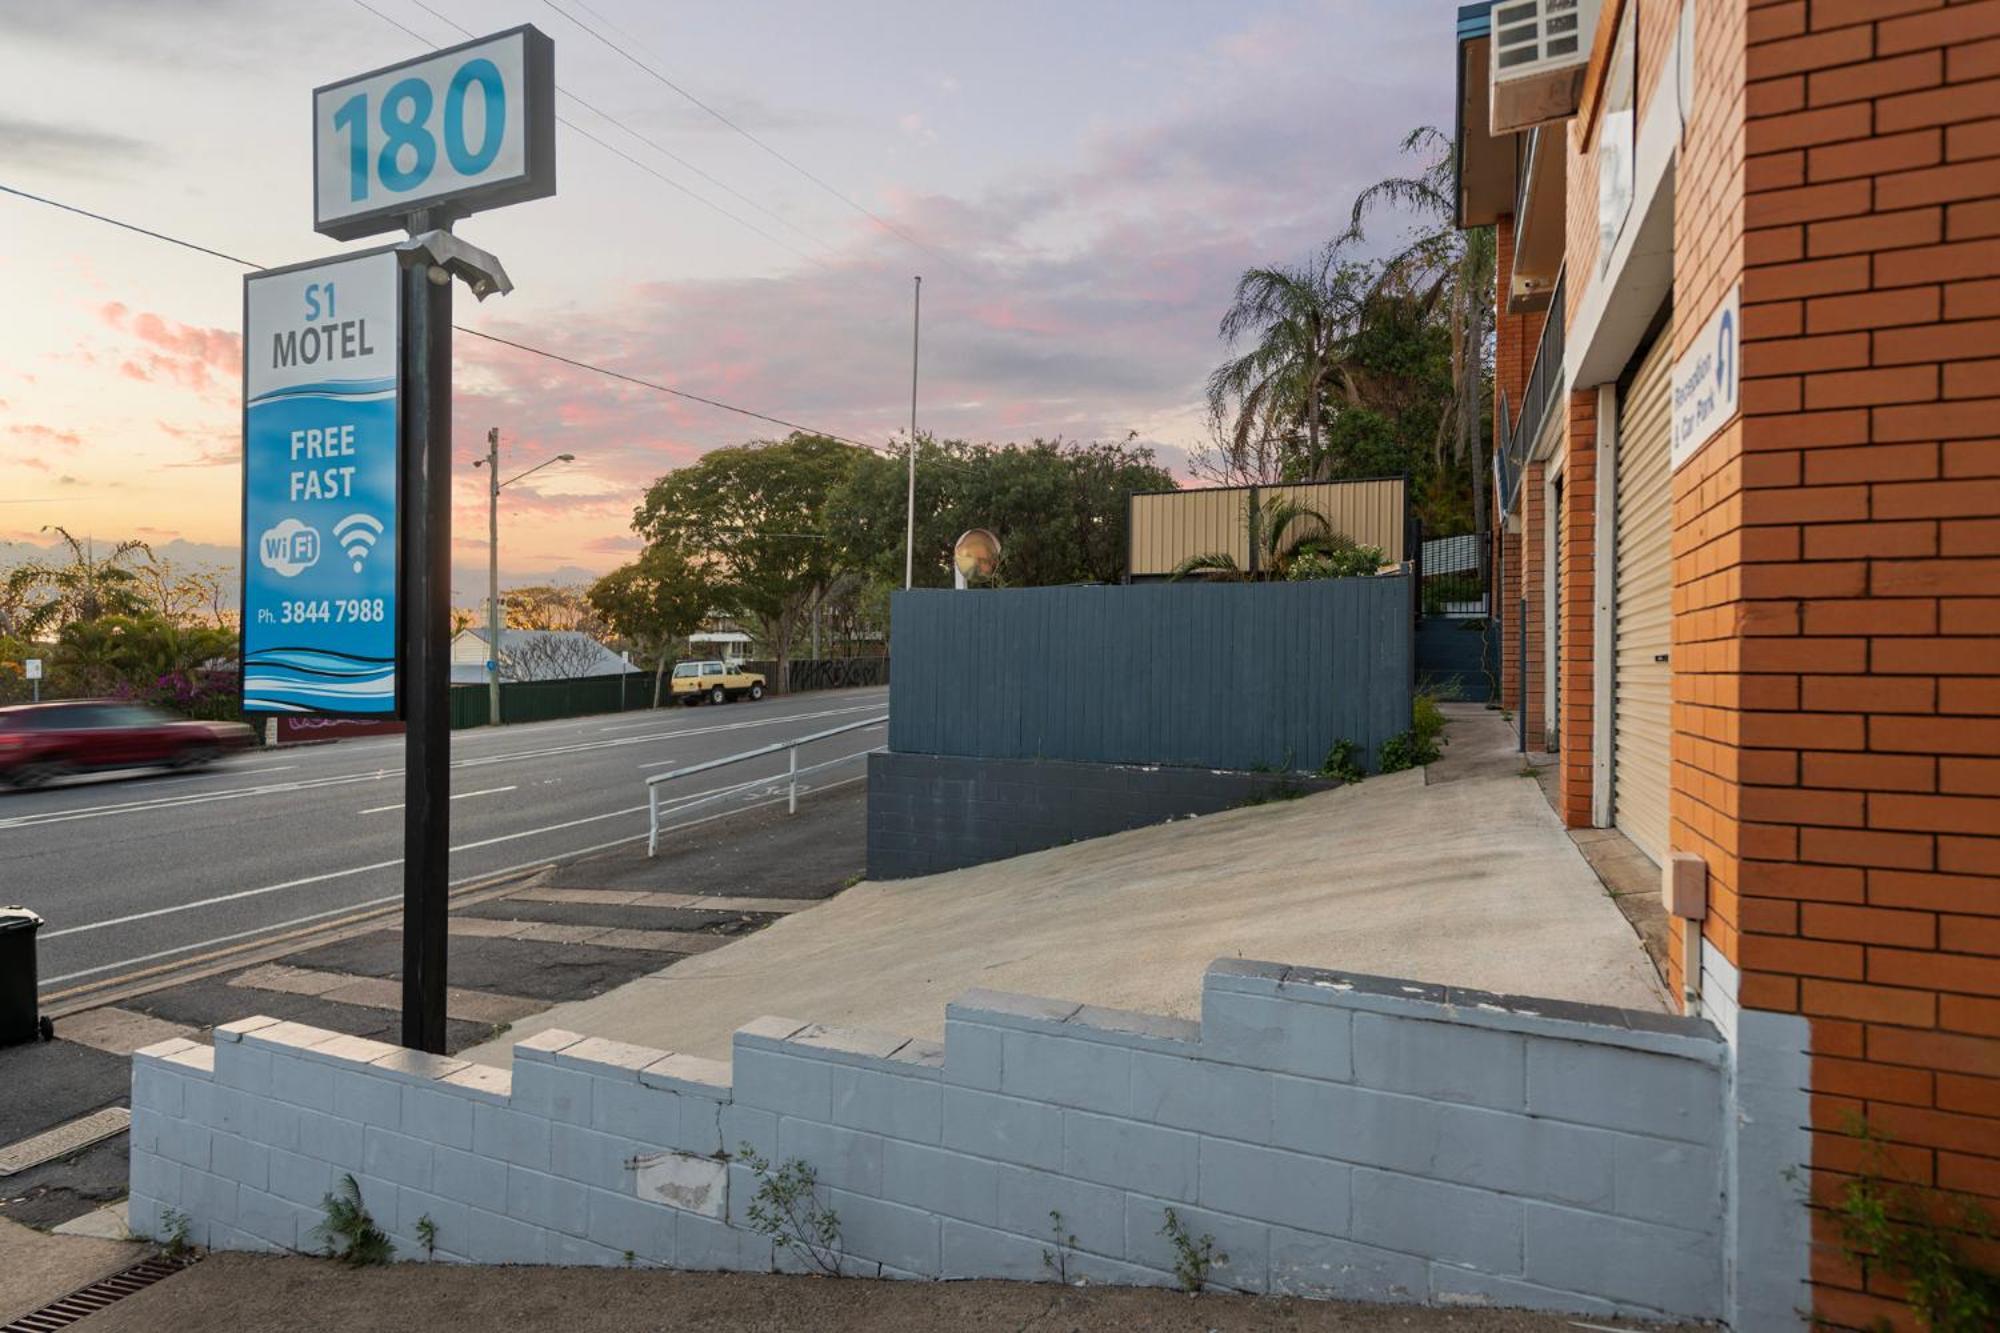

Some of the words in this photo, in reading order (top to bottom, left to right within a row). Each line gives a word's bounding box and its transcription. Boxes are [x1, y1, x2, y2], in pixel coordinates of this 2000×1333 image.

[333, 58, 506, 202] 180
[304, 282, 336, 322] S1
[272, 319, 375, 369] MOTEL
[290, 425, 356, 460] FREE
[290, 467, 356, 501] FAST
[258, 609, 277, 624] Ph.
[281, 601, 331, 624] 3844
[335, 598, 384, 623] 7988
